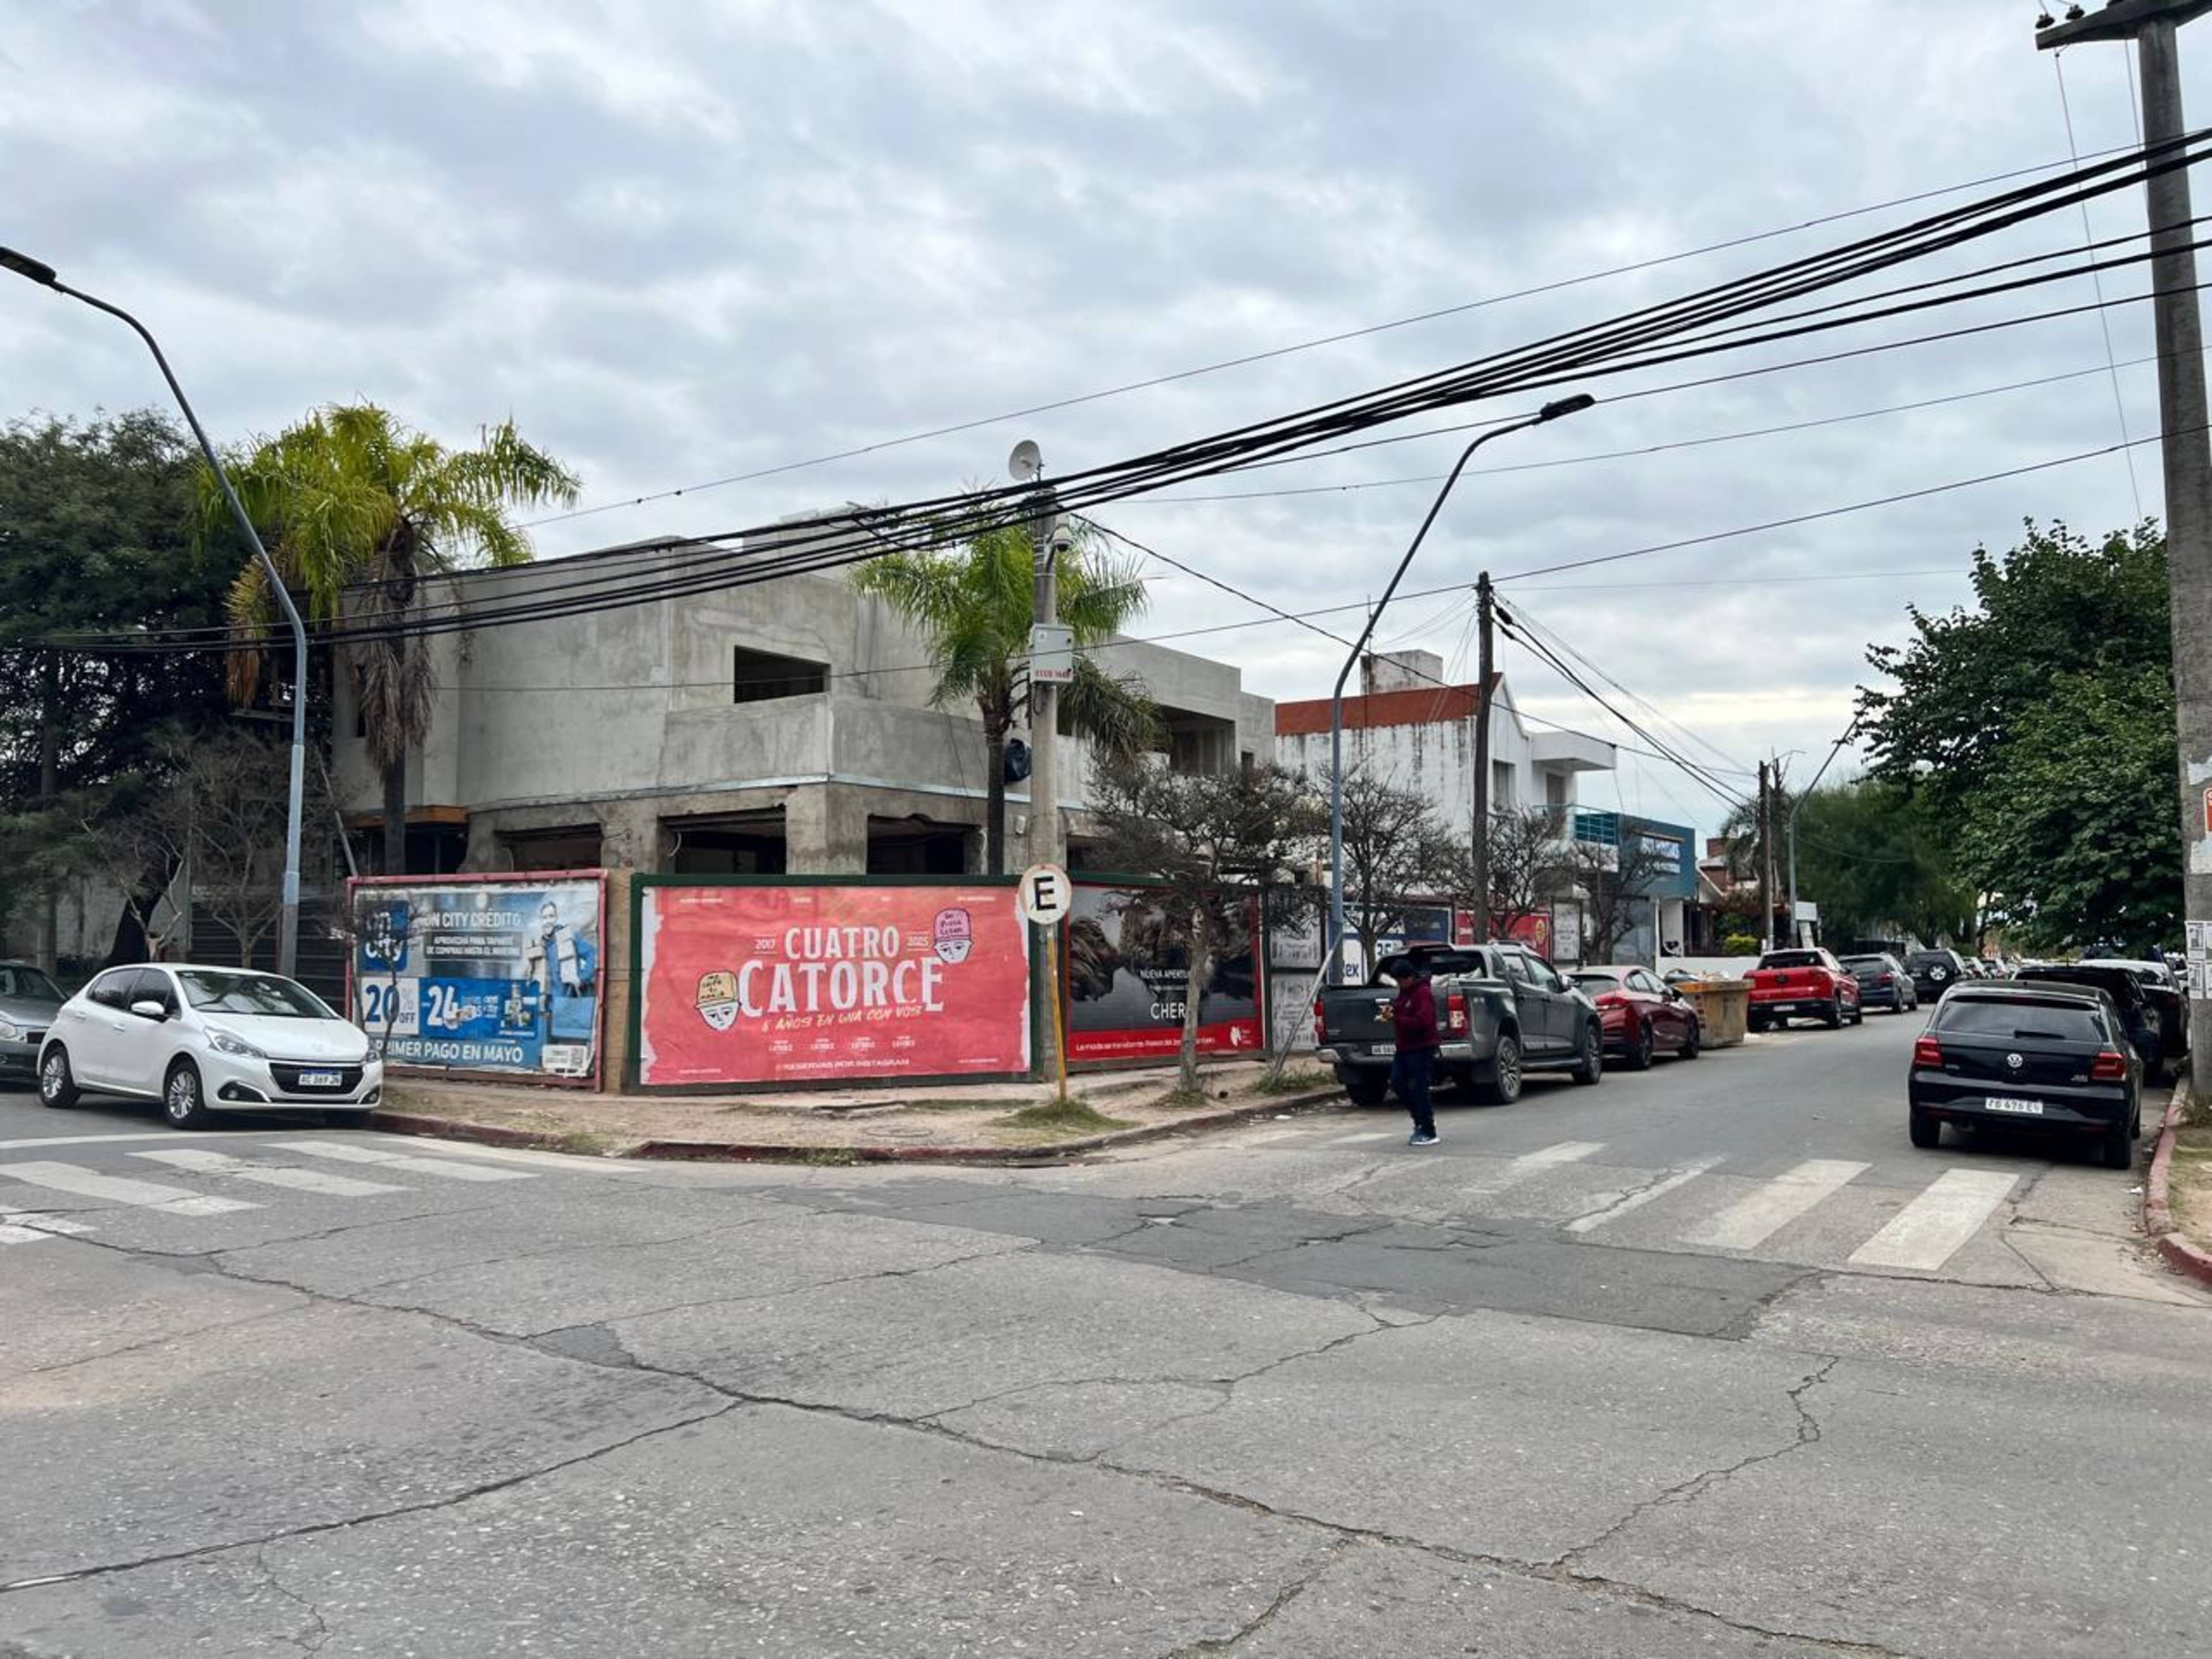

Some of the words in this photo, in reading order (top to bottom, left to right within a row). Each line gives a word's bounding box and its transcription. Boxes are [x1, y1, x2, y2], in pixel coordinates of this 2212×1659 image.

[1033, 876, 1056, 911] E
[442, 912, 468, 927] CITY
[785, 926, 899, 960] CUATRO
[738, 957, 944, 1018] CATORCE
[399, 1012, 416, 1024] OFF
[424, 1041, 459, 1059] PAGO
[462, 1043, 480, 1060] EN
[483, 1044, 524, 1063] MAYO
